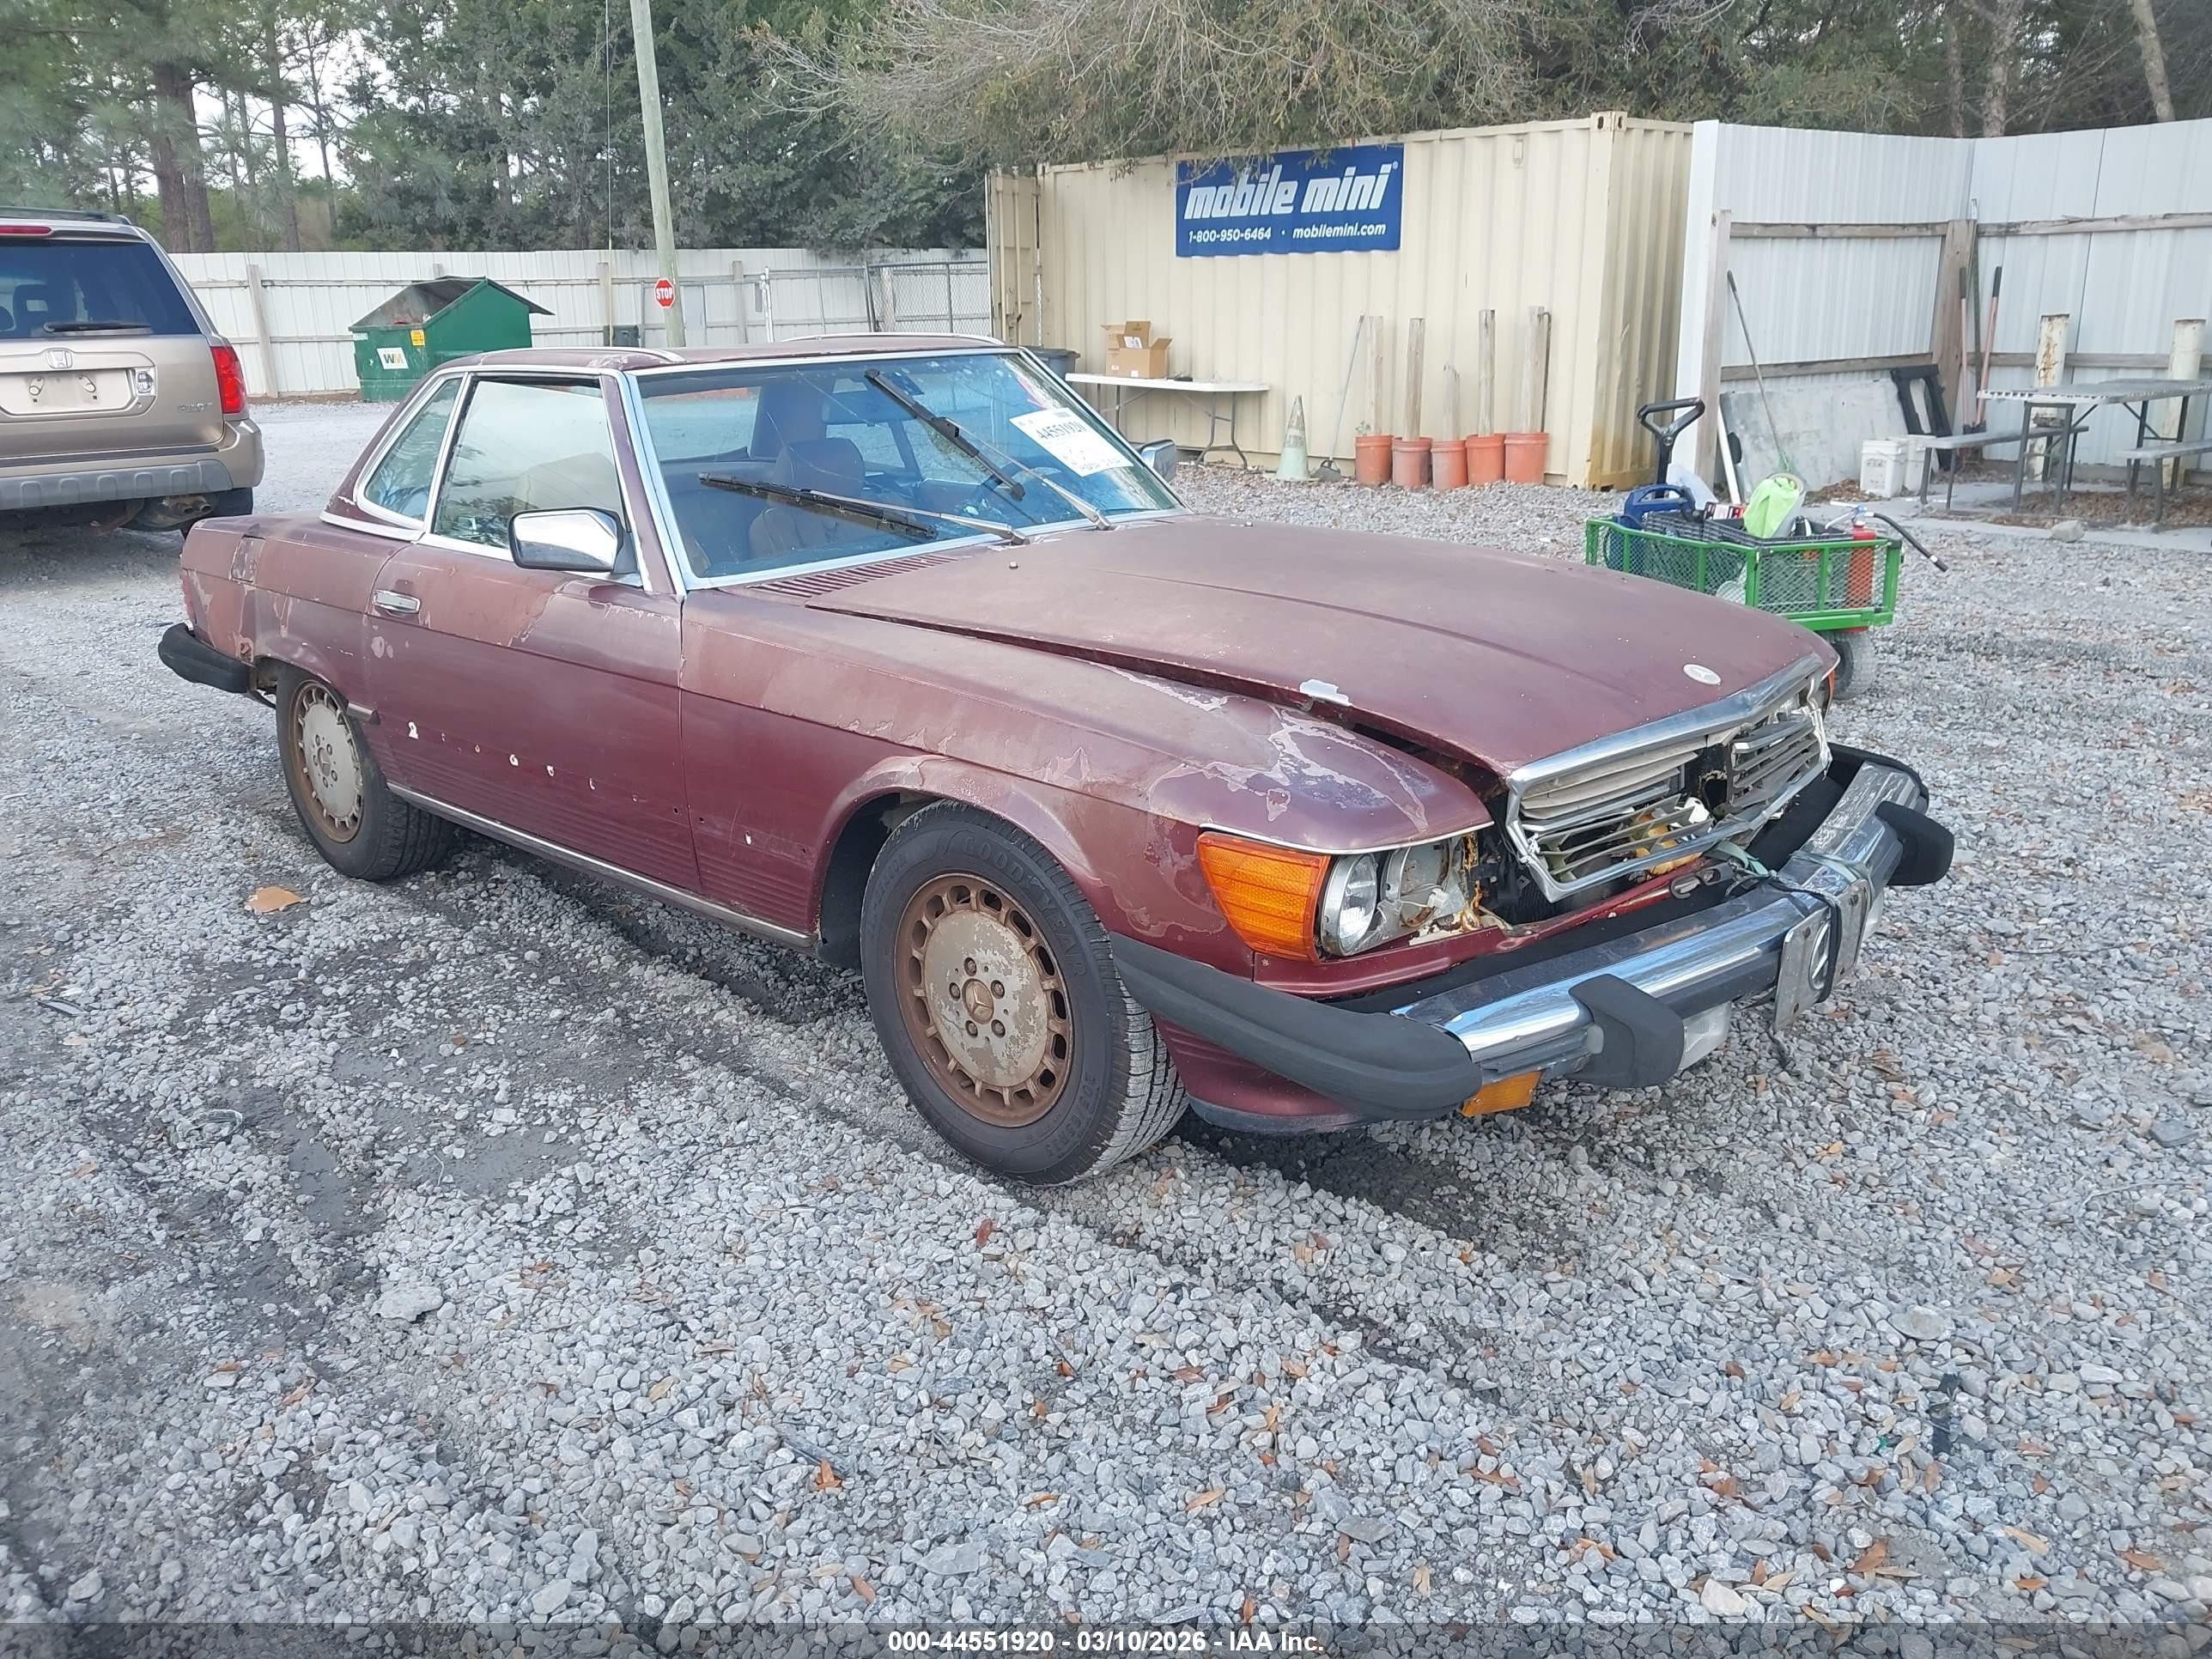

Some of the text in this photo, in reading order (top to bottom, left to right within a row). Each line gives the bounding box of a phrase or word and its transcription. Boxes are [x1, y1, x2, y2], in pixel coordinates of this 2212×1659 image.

[1183, 164, 1298, 220] mobile
[1188, 222, 1387, 243] 1-800-950-6464 mobilemini.com
[655, 287, 673, 300] STOP
[383, 353, 404, 364] WM
